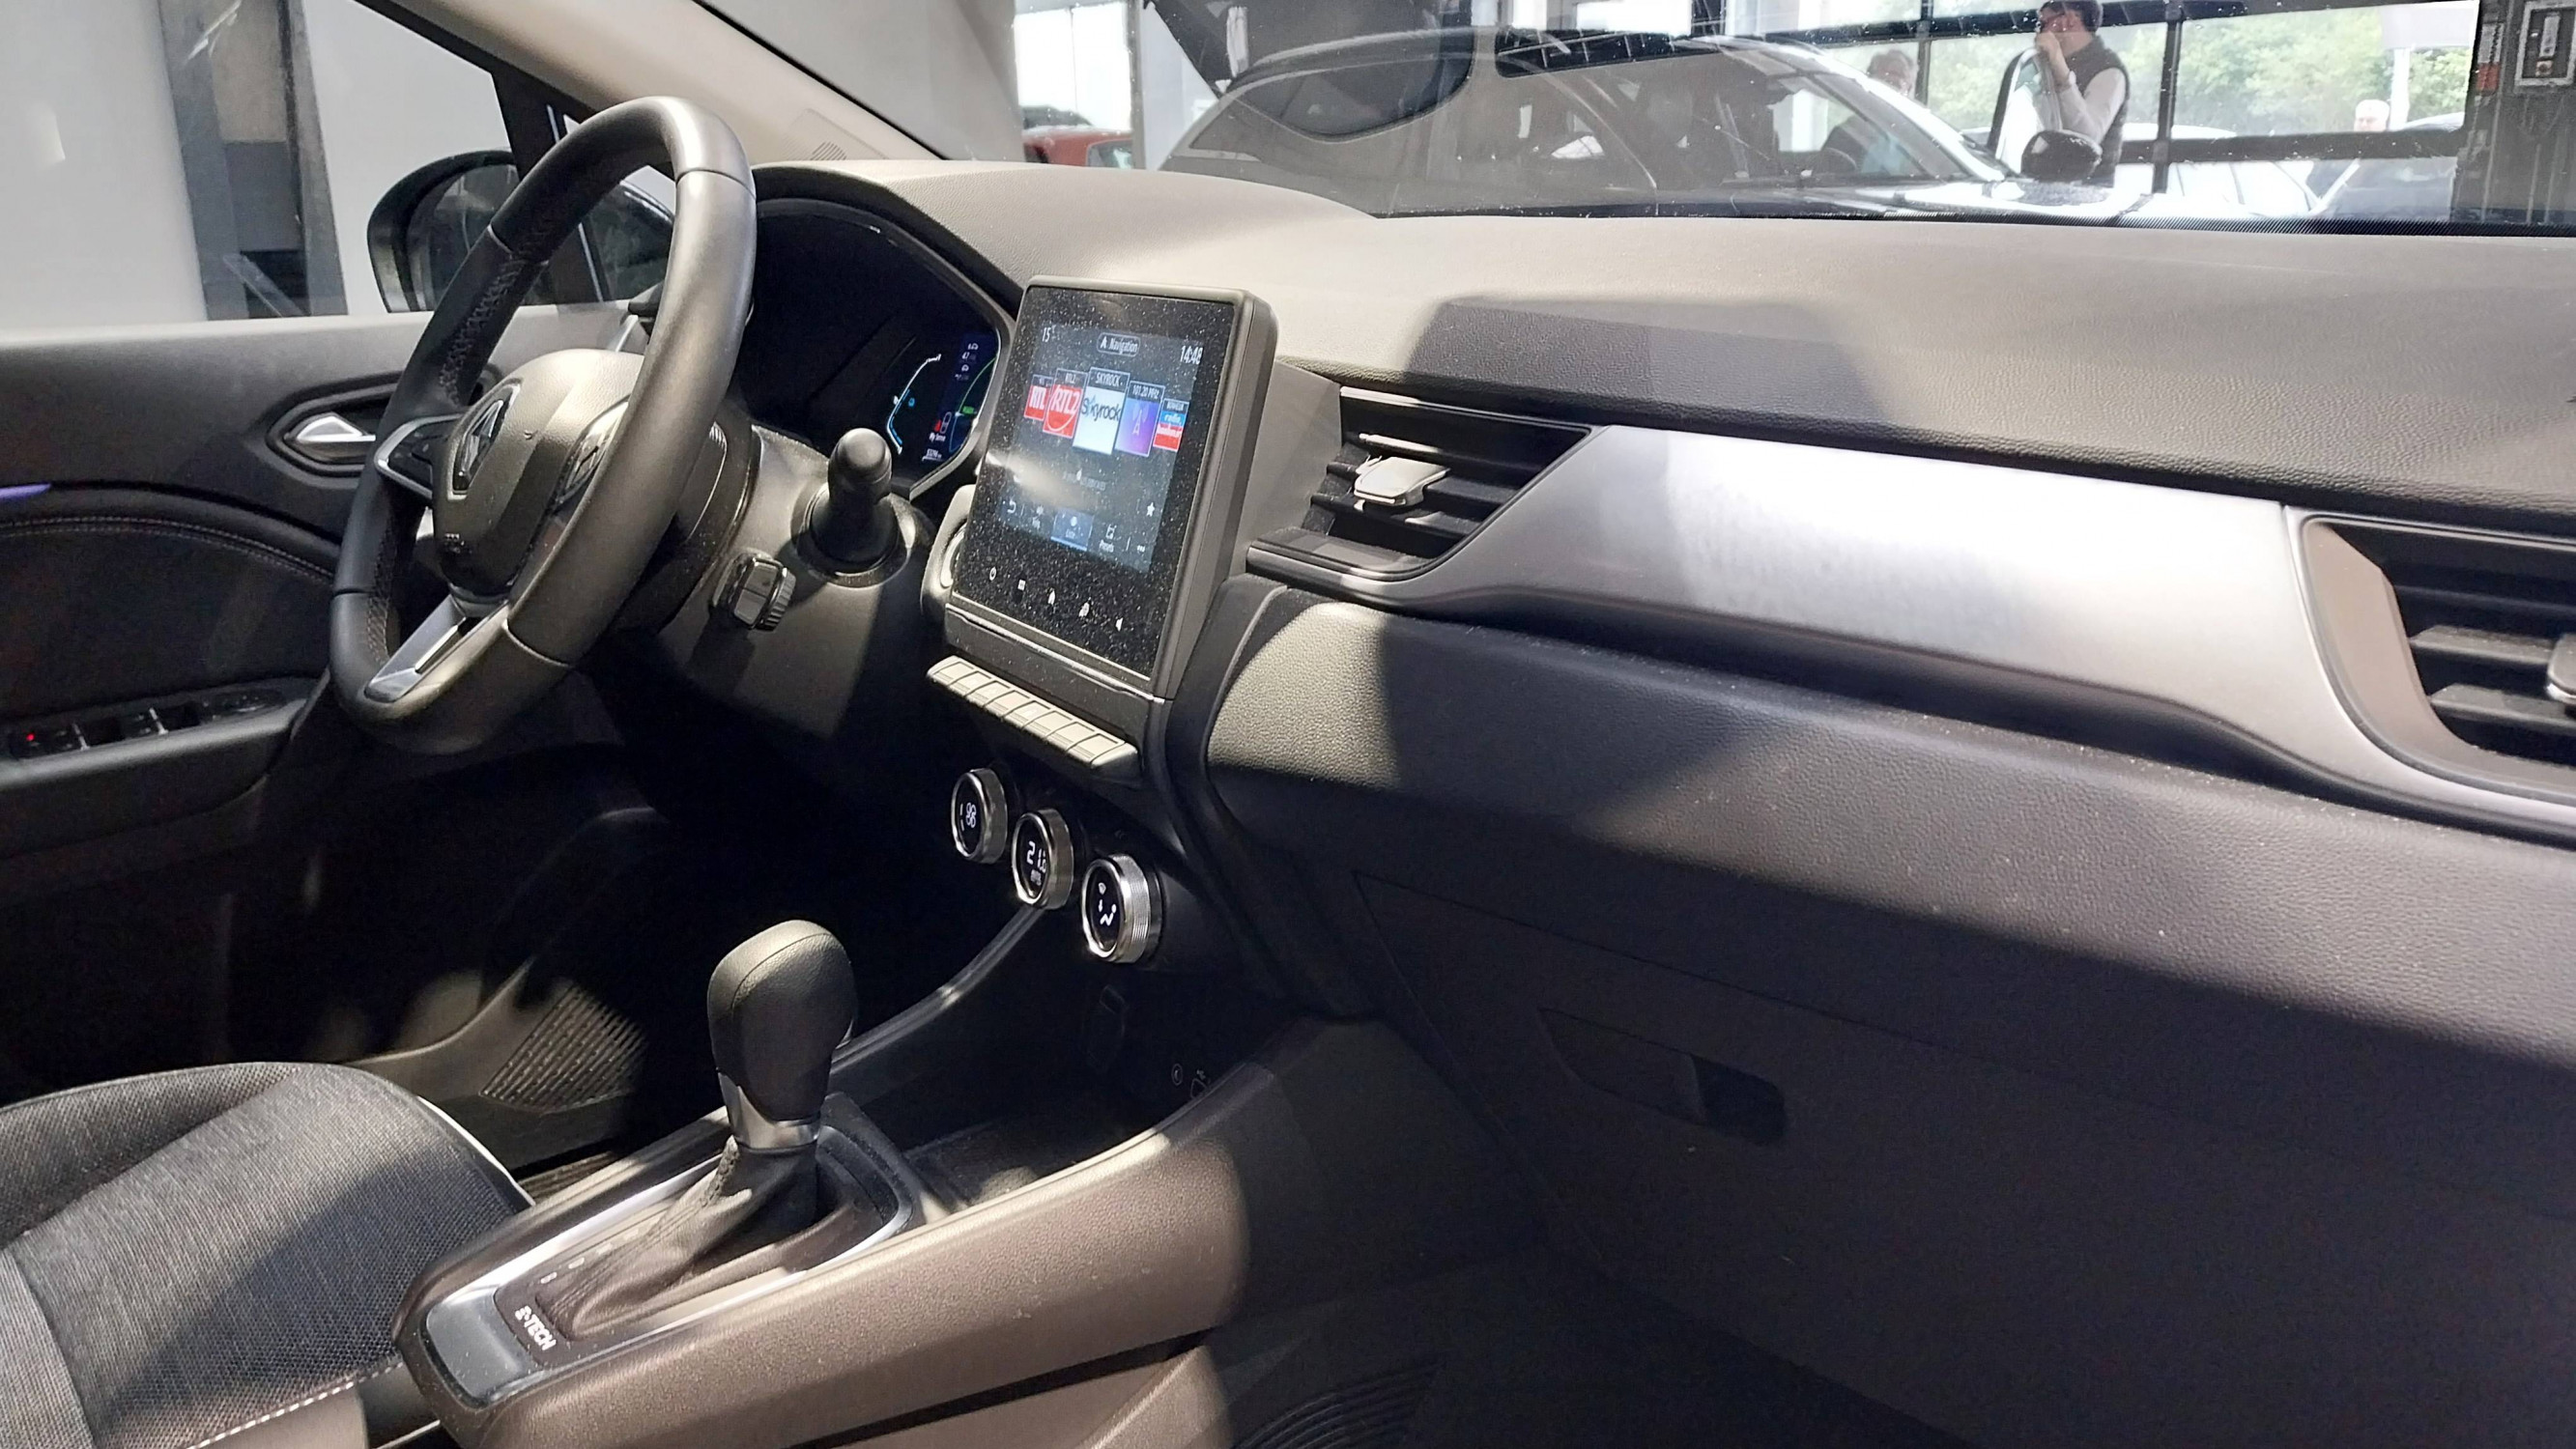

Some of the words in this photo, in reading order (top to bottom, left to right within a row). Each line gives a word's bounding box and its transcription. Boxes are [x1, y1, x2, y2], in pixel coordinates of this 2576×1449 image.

[1108, 337, 1138, 355] Navigation
[1180, 345, 1204, 365] 14:48
[1095, 371, 1121, 387] SKYROCK
[1028, 386, 1047, 411] RTL
